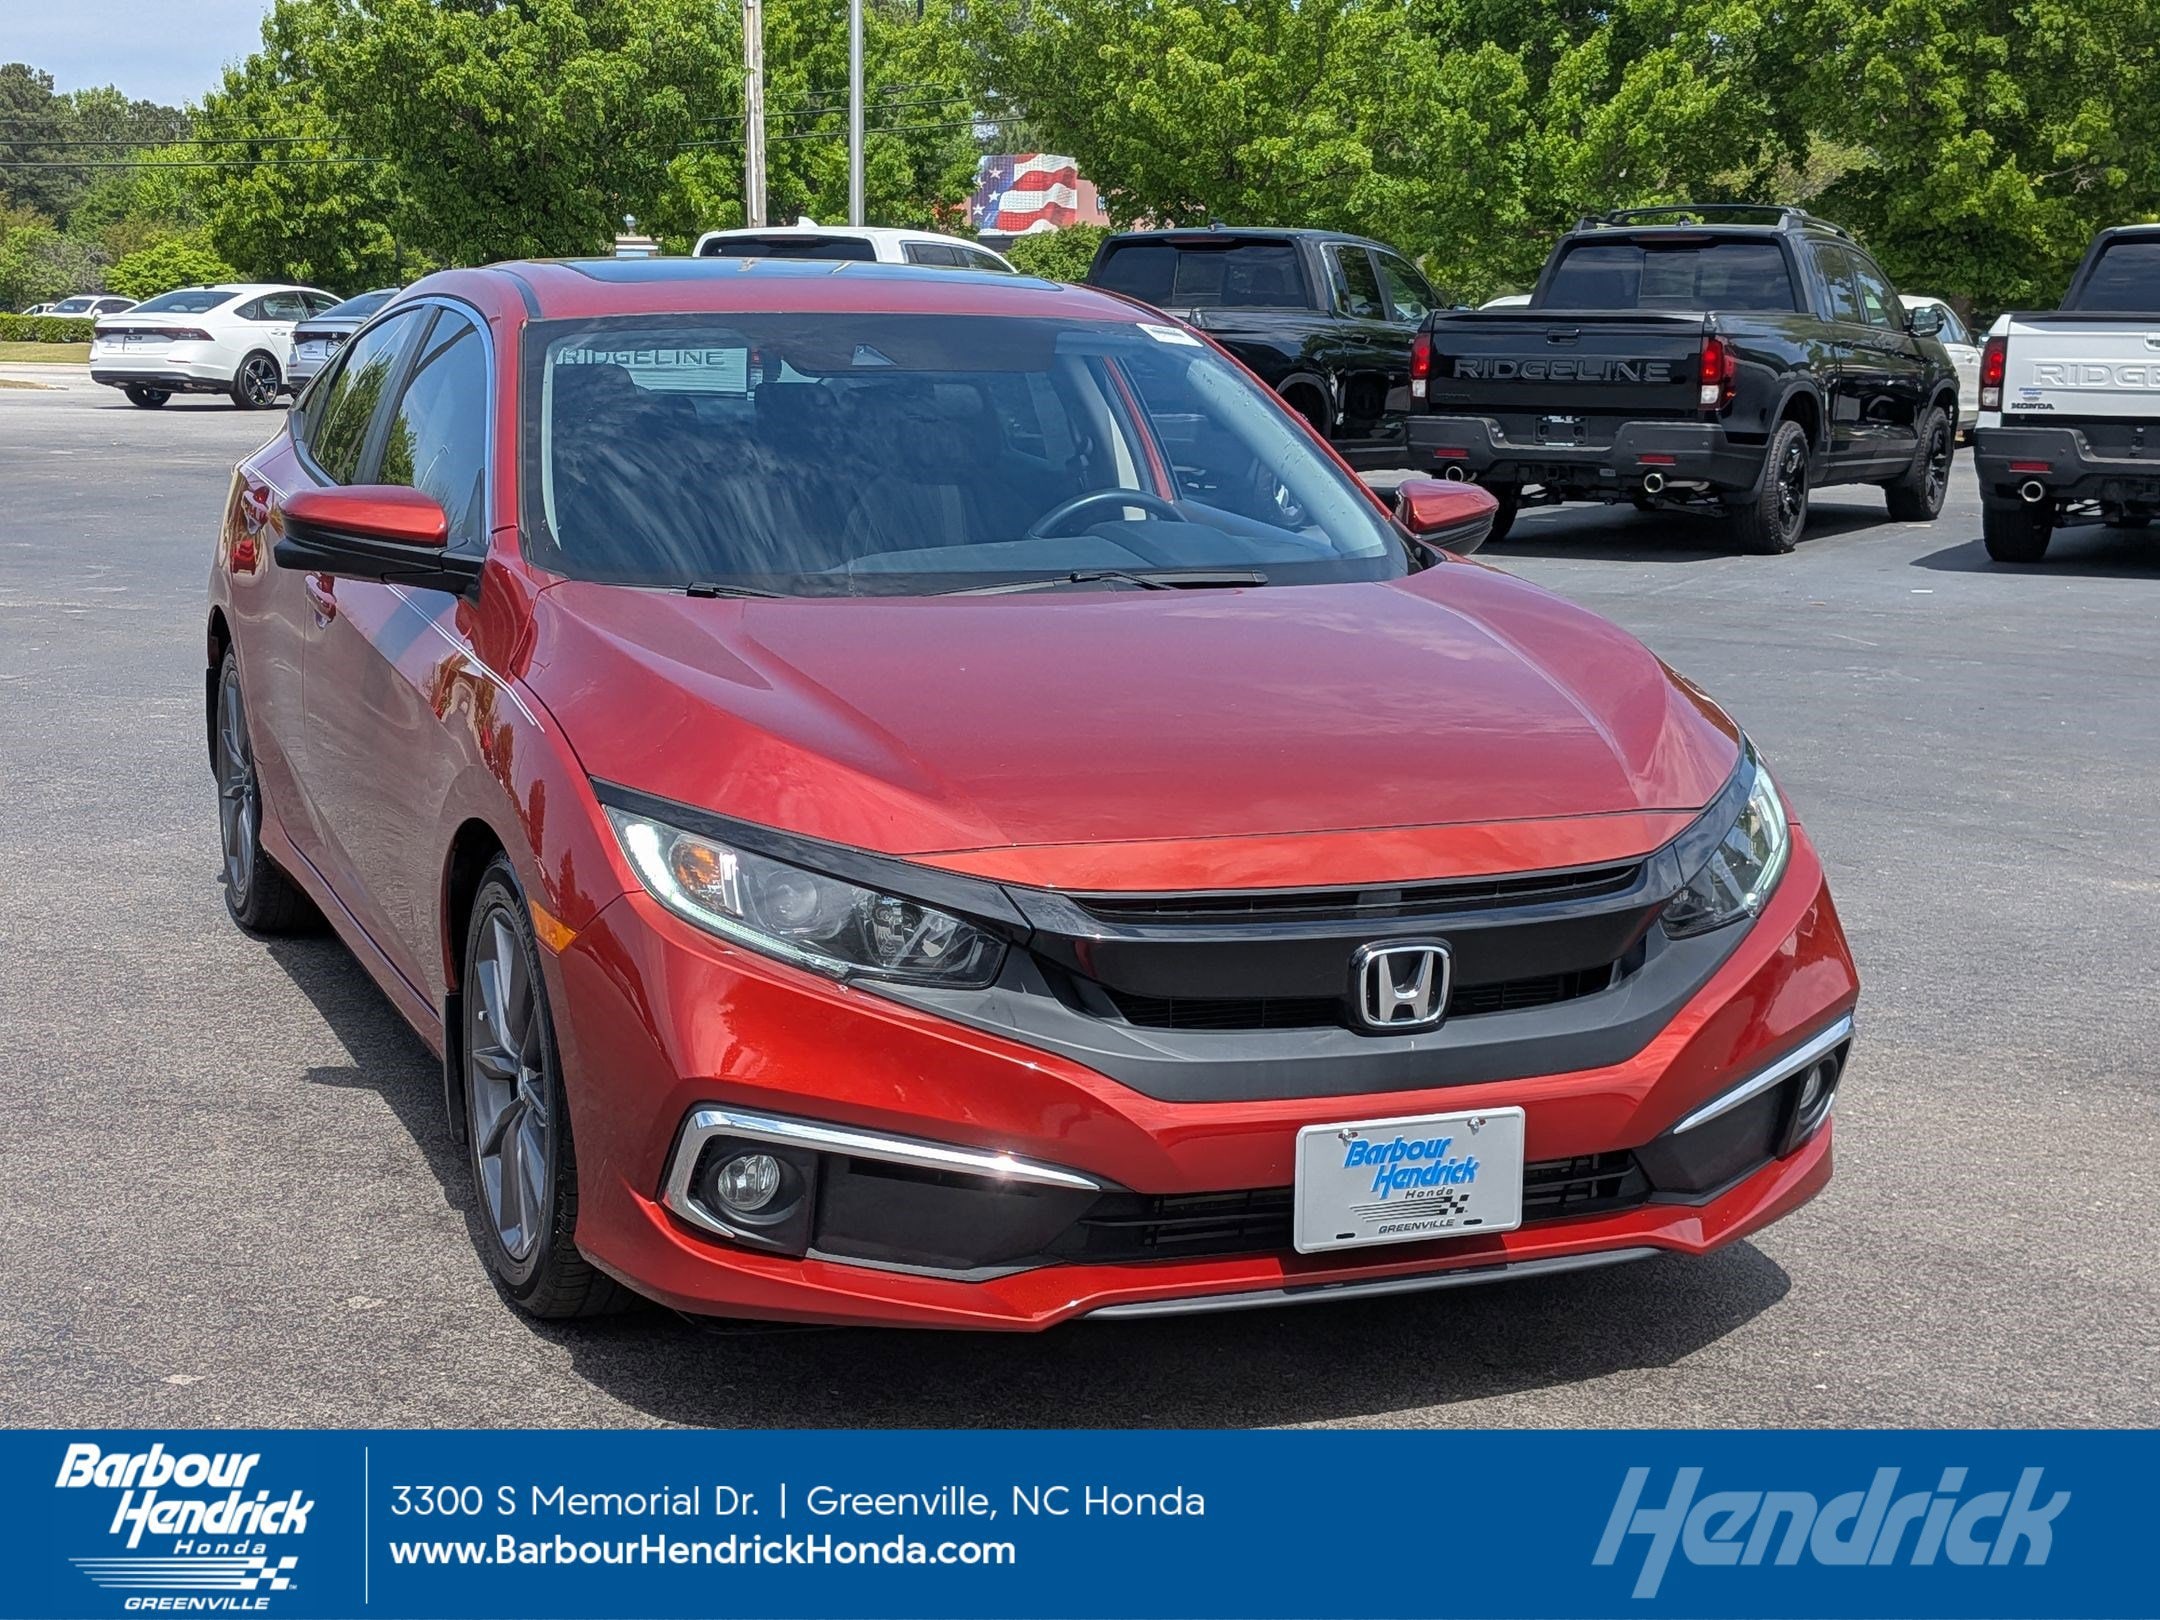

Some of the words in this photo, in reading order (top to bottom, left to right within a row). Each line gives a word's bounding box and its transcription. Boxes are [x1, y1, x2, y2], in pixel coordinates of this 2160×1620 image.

[1453, 358, 1672, 382] RIDGELINE
[2011, 402, 2055, 410] HONDA
[1344, 1136, 1453, 1168] Barbour
[1371, 1155, 1480, 1200] Hendrick
[1404, 1187, 1454, 1200] Honda
[1378, 1218, 1456, 1235] GREENVILLE
